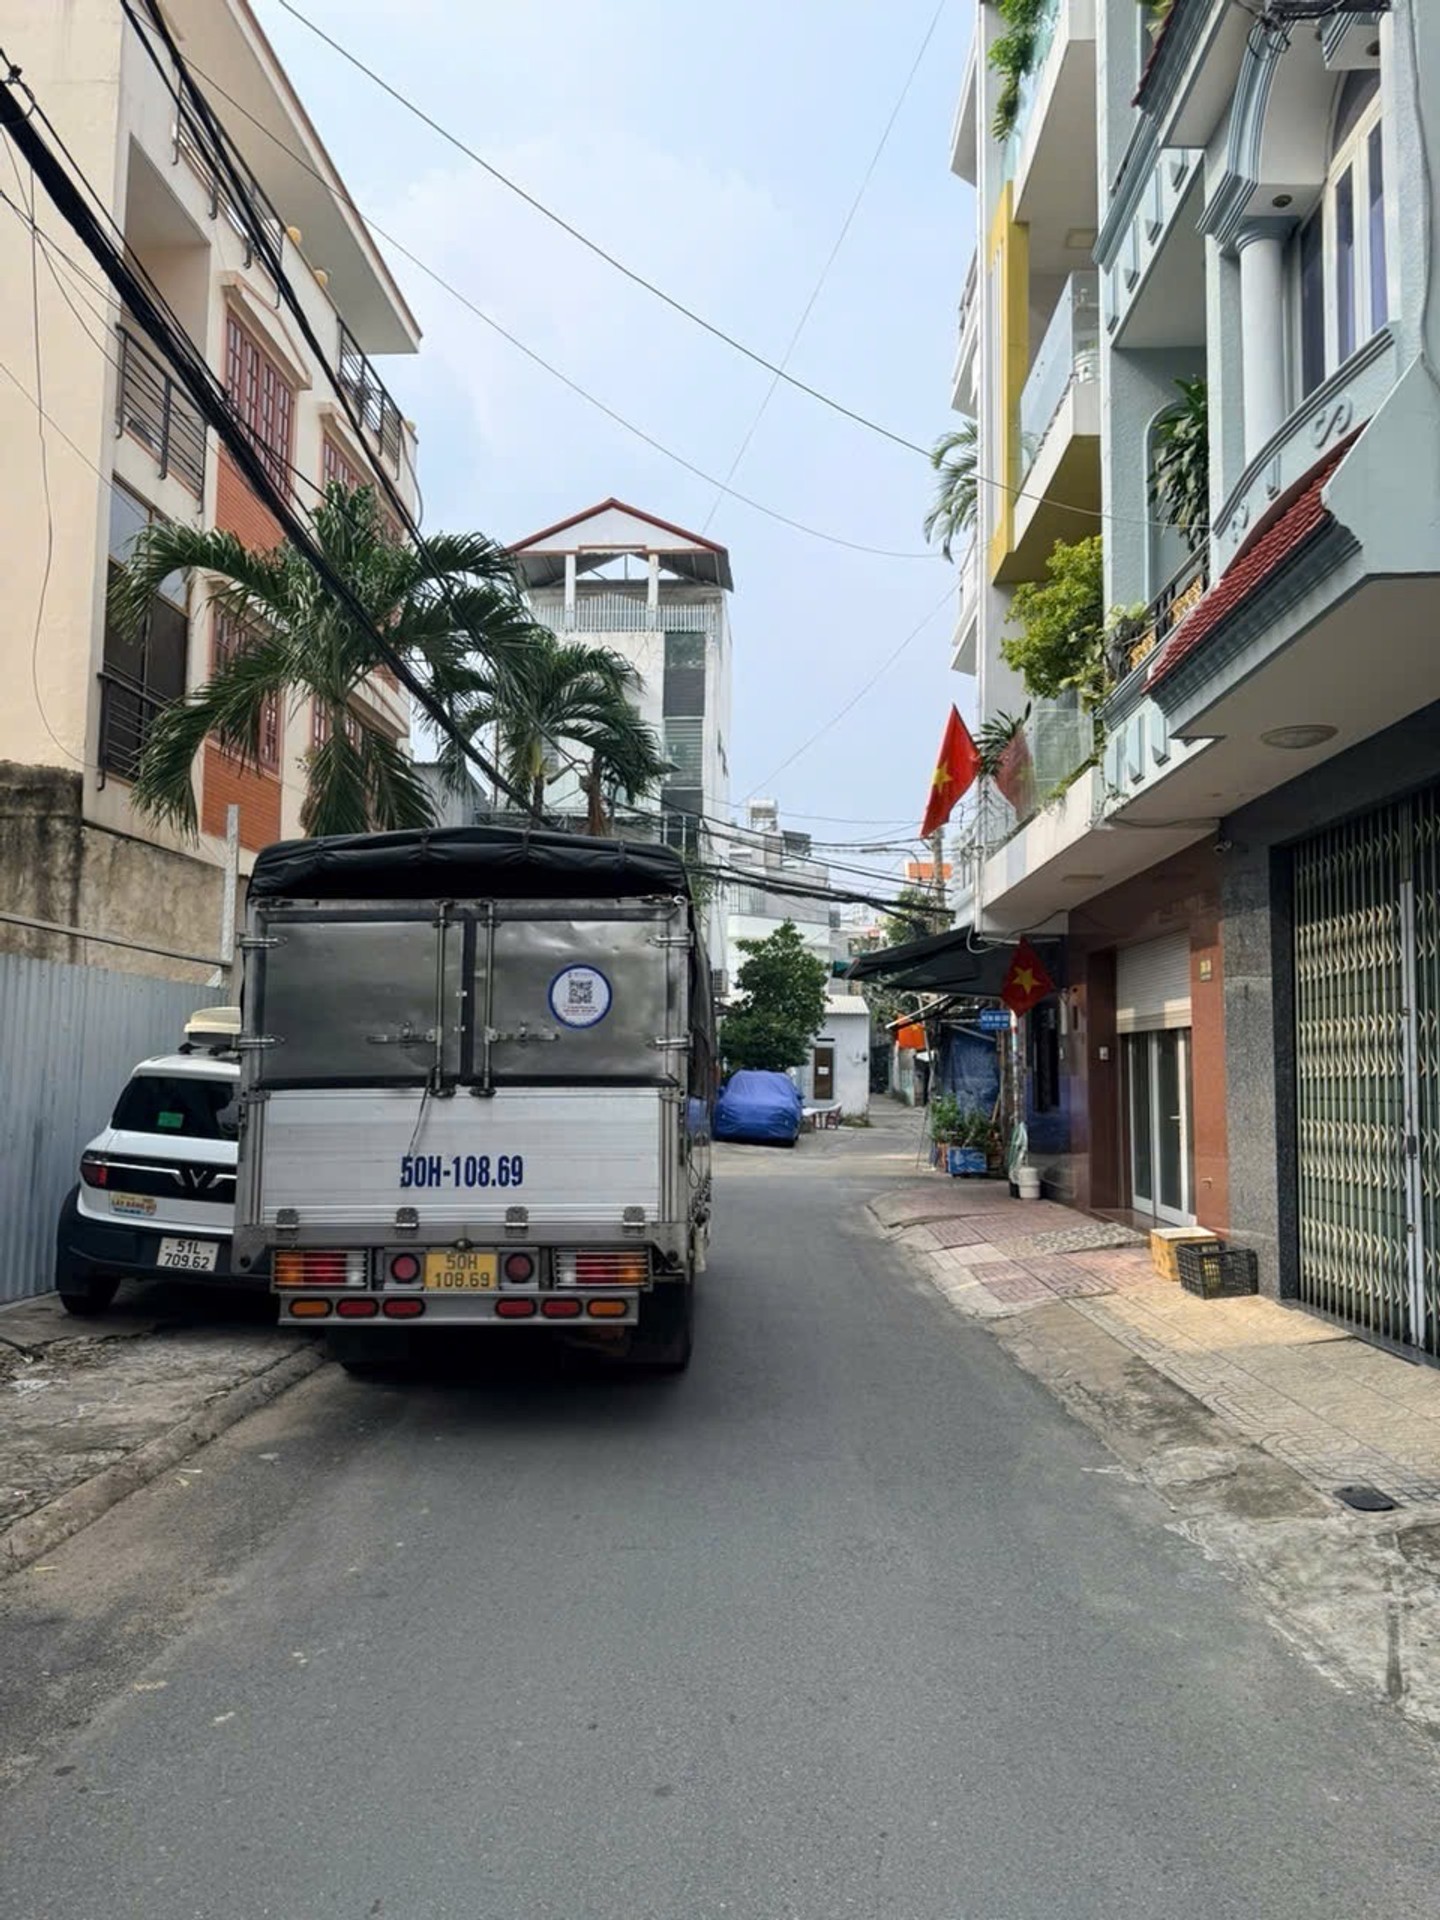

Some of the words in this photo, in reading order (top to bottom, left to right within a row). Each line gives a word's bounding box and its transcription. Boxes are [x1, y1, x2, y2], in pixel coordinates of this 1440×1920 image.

[400, 1155, 523, 1188] 50H-108.69
[176, 1240, 201, 1254] 51L
[165, 1253, 210, 1269] 709.62
[446, 1253, 478, 1270] 50H
[435, 1272, 490, 1287] 108.69
